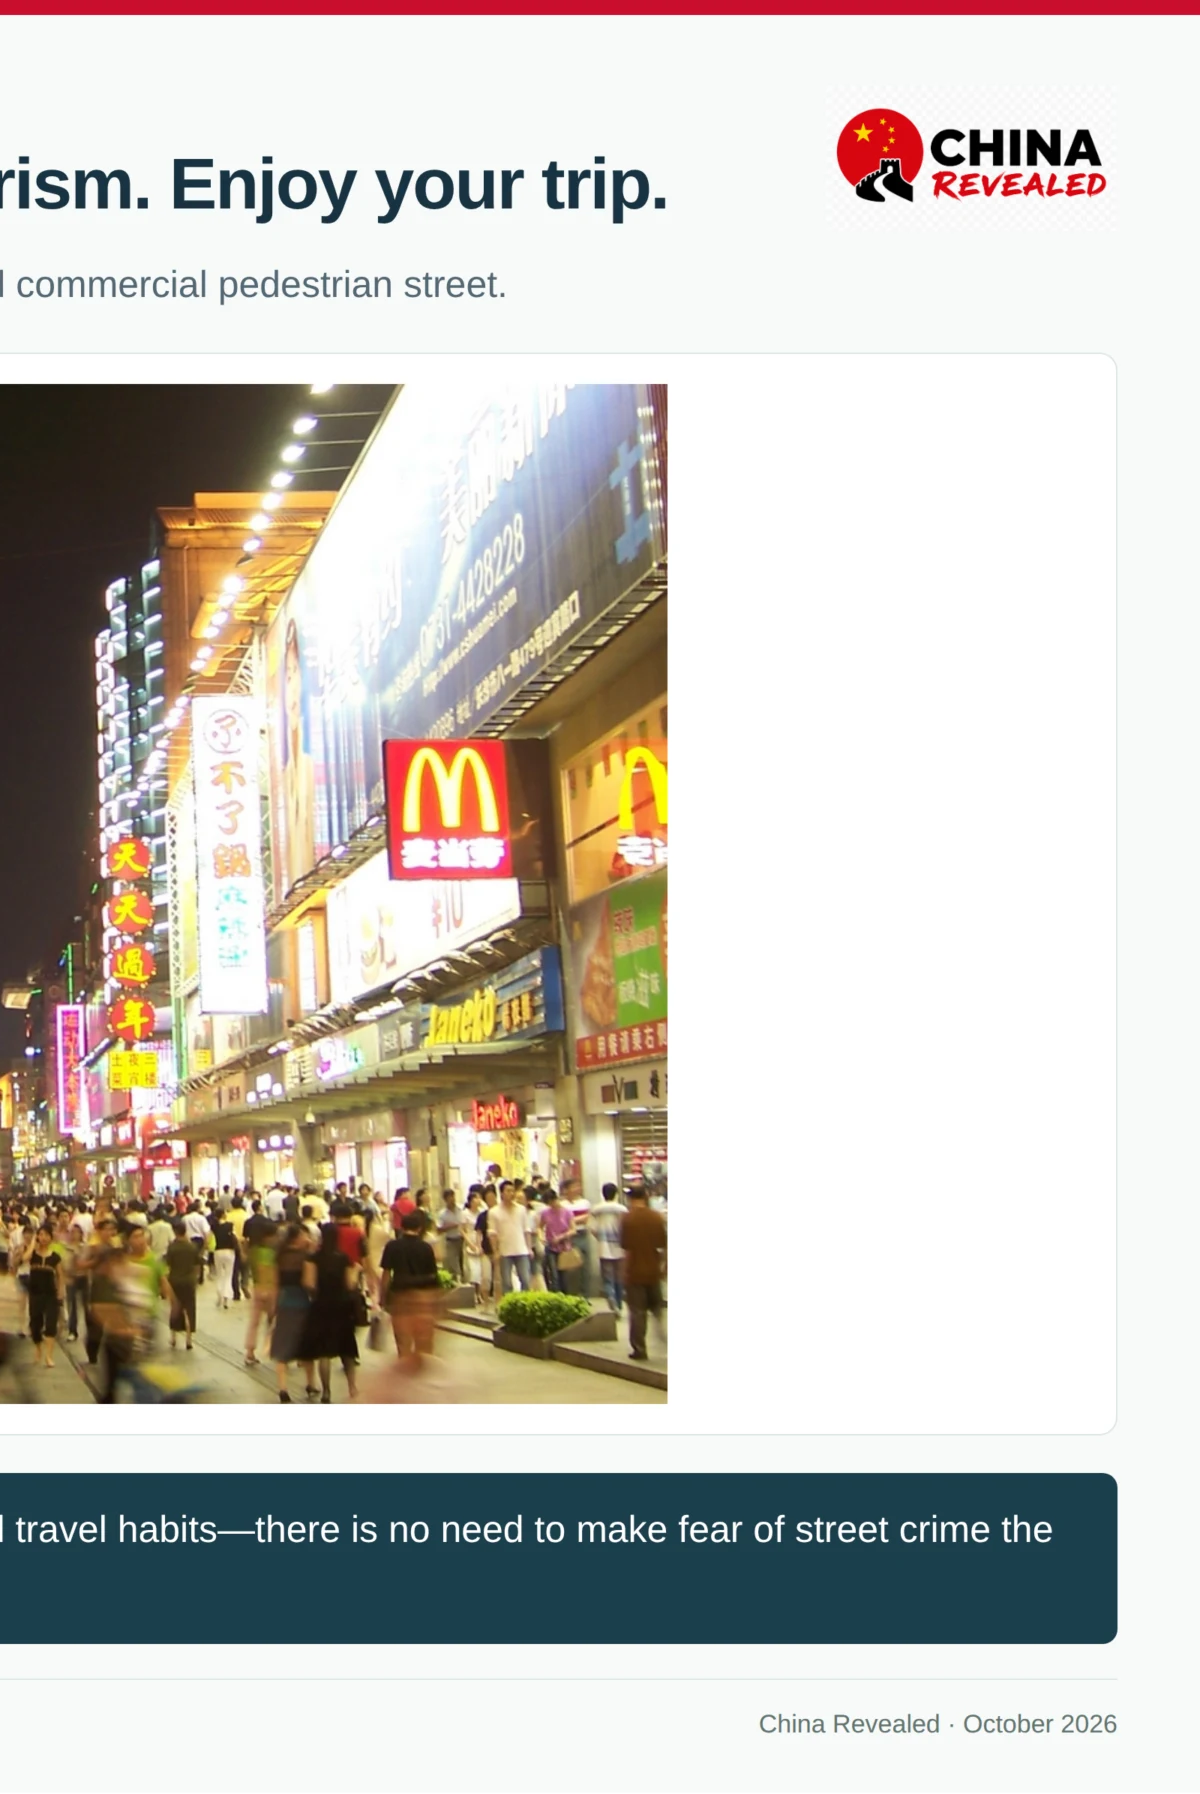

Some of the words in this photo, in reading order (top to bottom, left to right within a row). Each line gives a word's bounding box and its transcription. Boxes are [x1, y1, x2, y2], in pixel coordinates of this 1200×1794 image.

[111, 841, 150, 1039] 天天過年
[424, 985, 497, 1049] Janeko
[472, 1093, 519, 1131] Janeko
